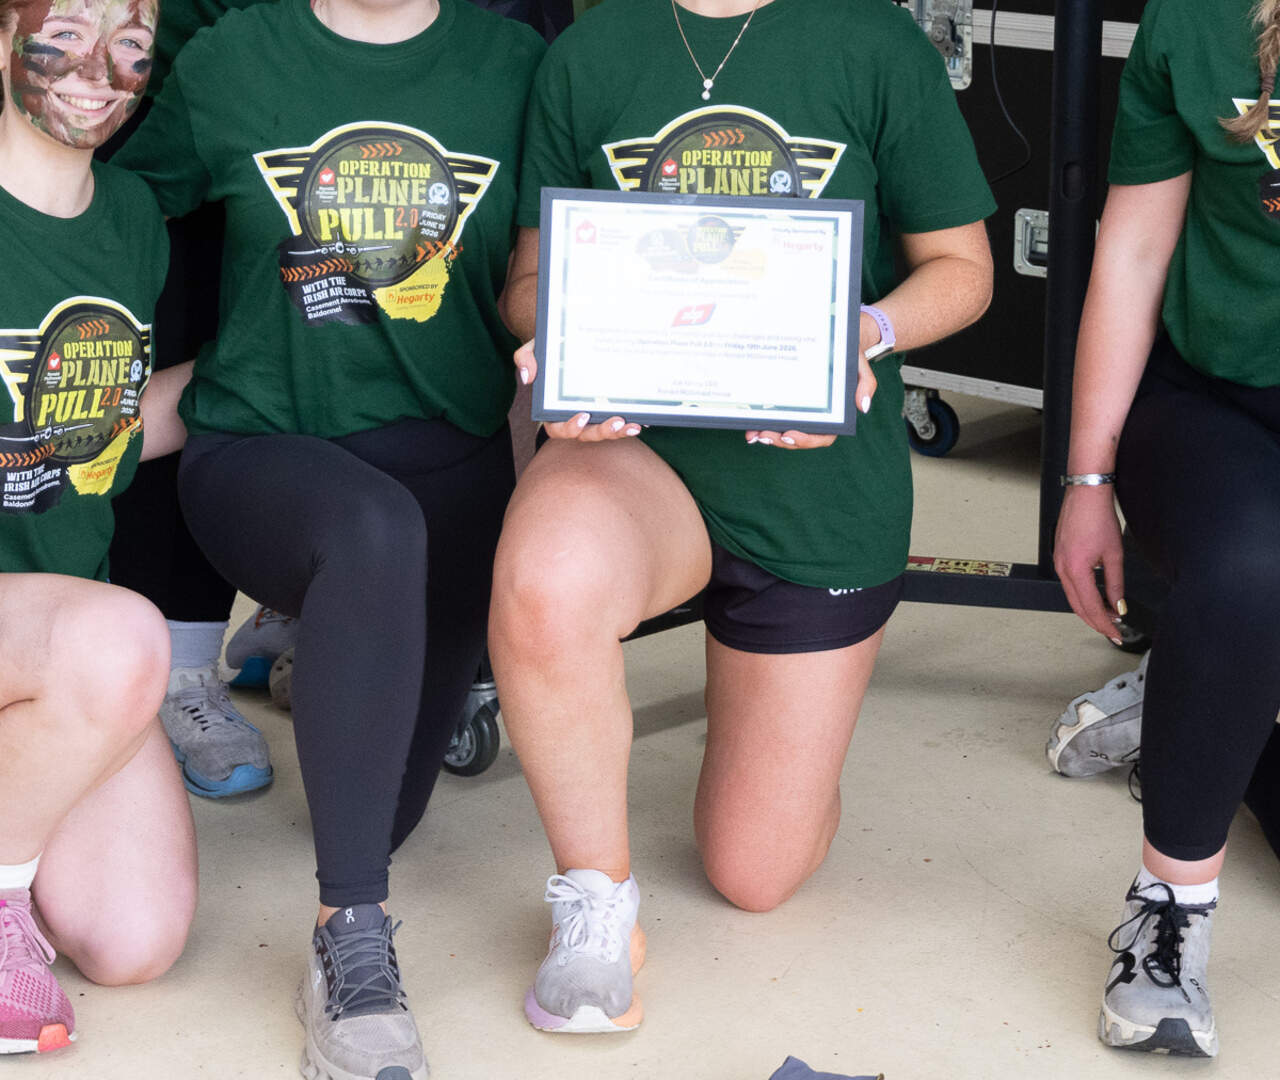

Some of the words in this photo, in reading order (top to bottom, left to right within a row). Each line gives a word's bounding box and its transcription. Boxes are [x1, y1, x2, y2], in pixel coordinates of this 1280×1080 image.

[339, 159, 431, 179] OPERATION
[681, 149, 773, 168] OPERATION
[336, 177, 427, 206] PLANE
[679, 167, 768, 196] PLANE
[318, 207, 404, 242] PULL
[395, 207, 418, 228] 2.0
[396, 292, 435, 304] Hegarty
[63, 340, 132, 359] OPERATION
[59, 357, 130, 388] PLANE
[37, 388, 105, 427] PULL
[100, 387, 122, 407] 2.0
